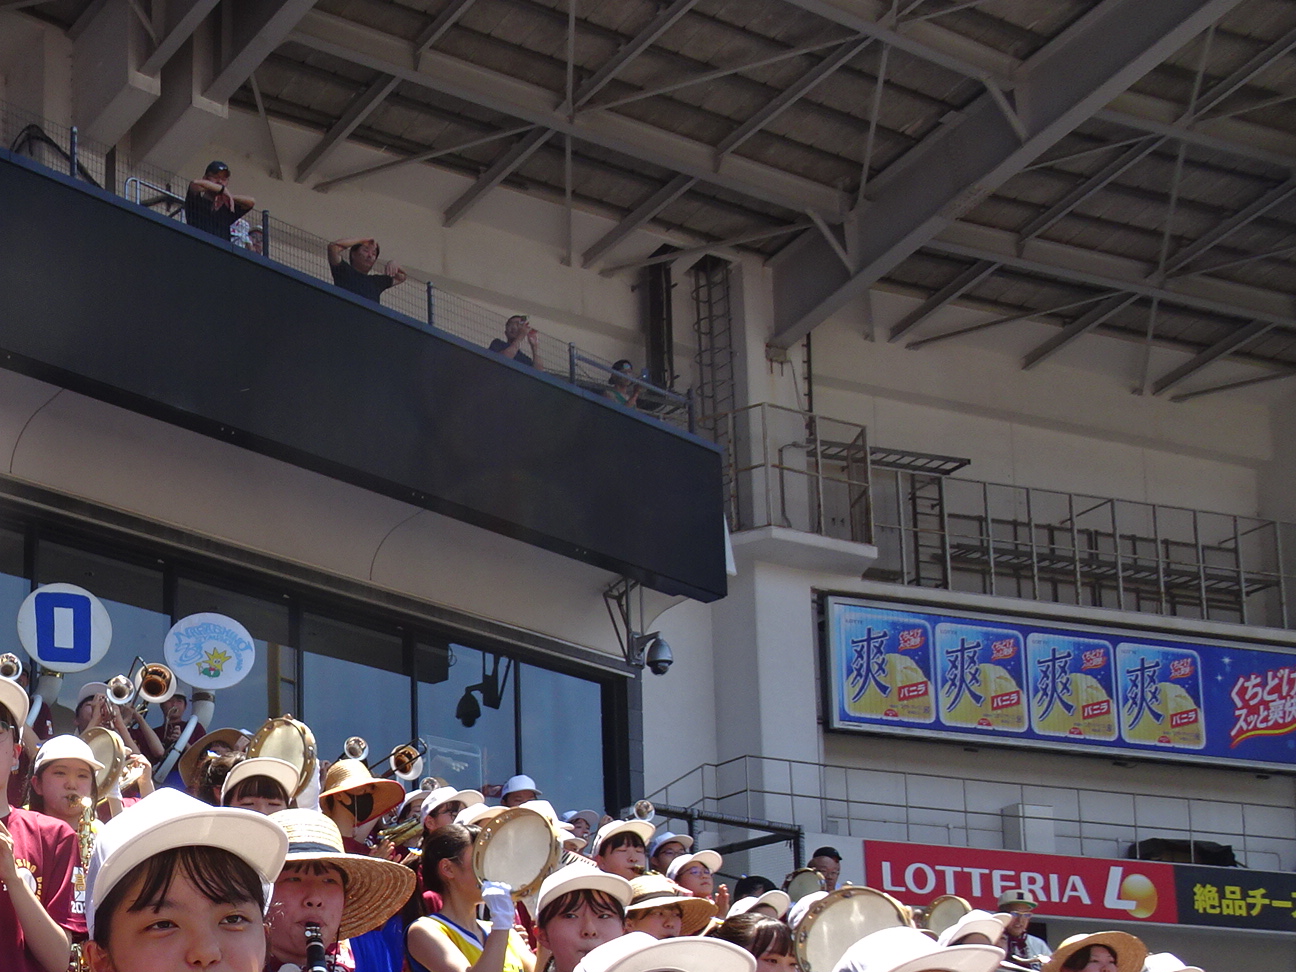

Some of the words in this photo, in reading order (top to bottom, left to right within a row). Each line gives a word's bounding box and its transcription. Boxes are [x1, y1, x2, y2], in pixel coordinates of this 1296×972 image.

[34, 592, 91, 663] O
[850, 626, 892, 703] 爽
[945, 637, 985, 712] 爽
[900, 683, 927, 698] バニラ
[993, 694, 1019, 708] バニラ
[1037, 647, 1075, 722] 爽
[1126, 657, 1164, 730] 爽
[1084, 703, 1109, 717] バニラ
[1172, 712, 1197, 725] バニラ
[881, 860, 1091, 905] LOTTERIA
[1193, 883, 1296, 917] 絶品チー
[70, 901, 86, 913] 20
